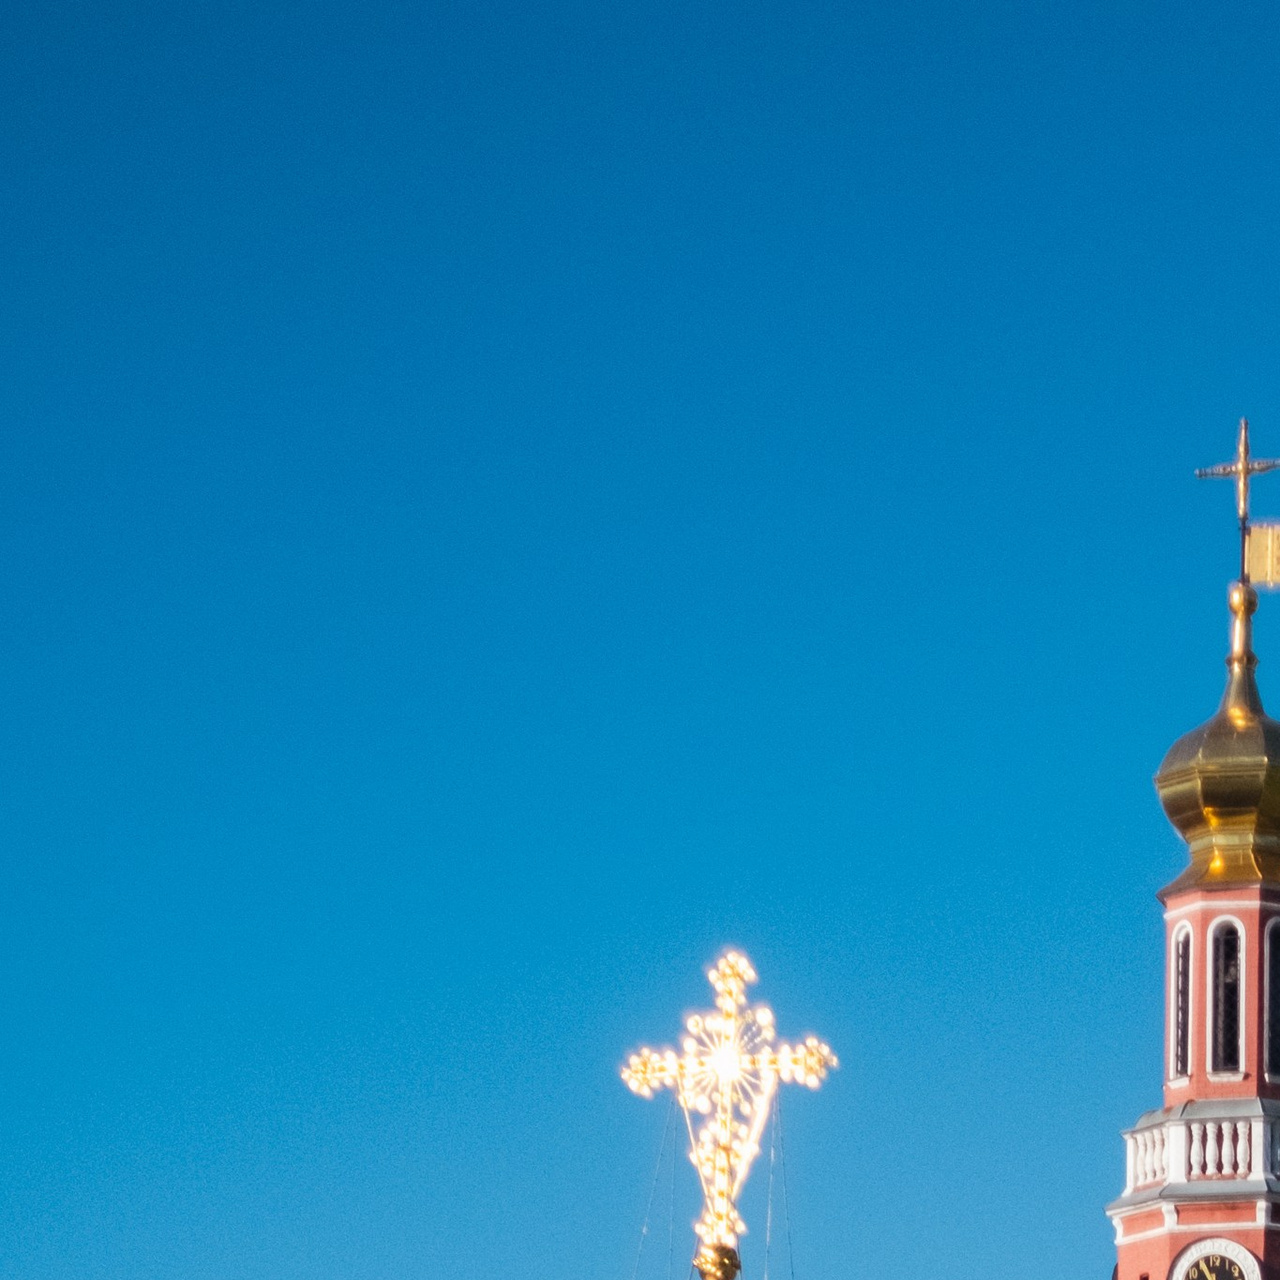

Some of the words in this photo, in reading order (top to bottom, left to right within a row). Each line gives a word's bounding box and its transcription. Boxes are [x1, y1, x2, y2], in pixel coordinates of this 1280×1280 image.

[1209, 1255, 1221, 1267] 12
[1189, 1267, 1198, 1280] 10
[1231, 1265, 1239, 1277] 2
